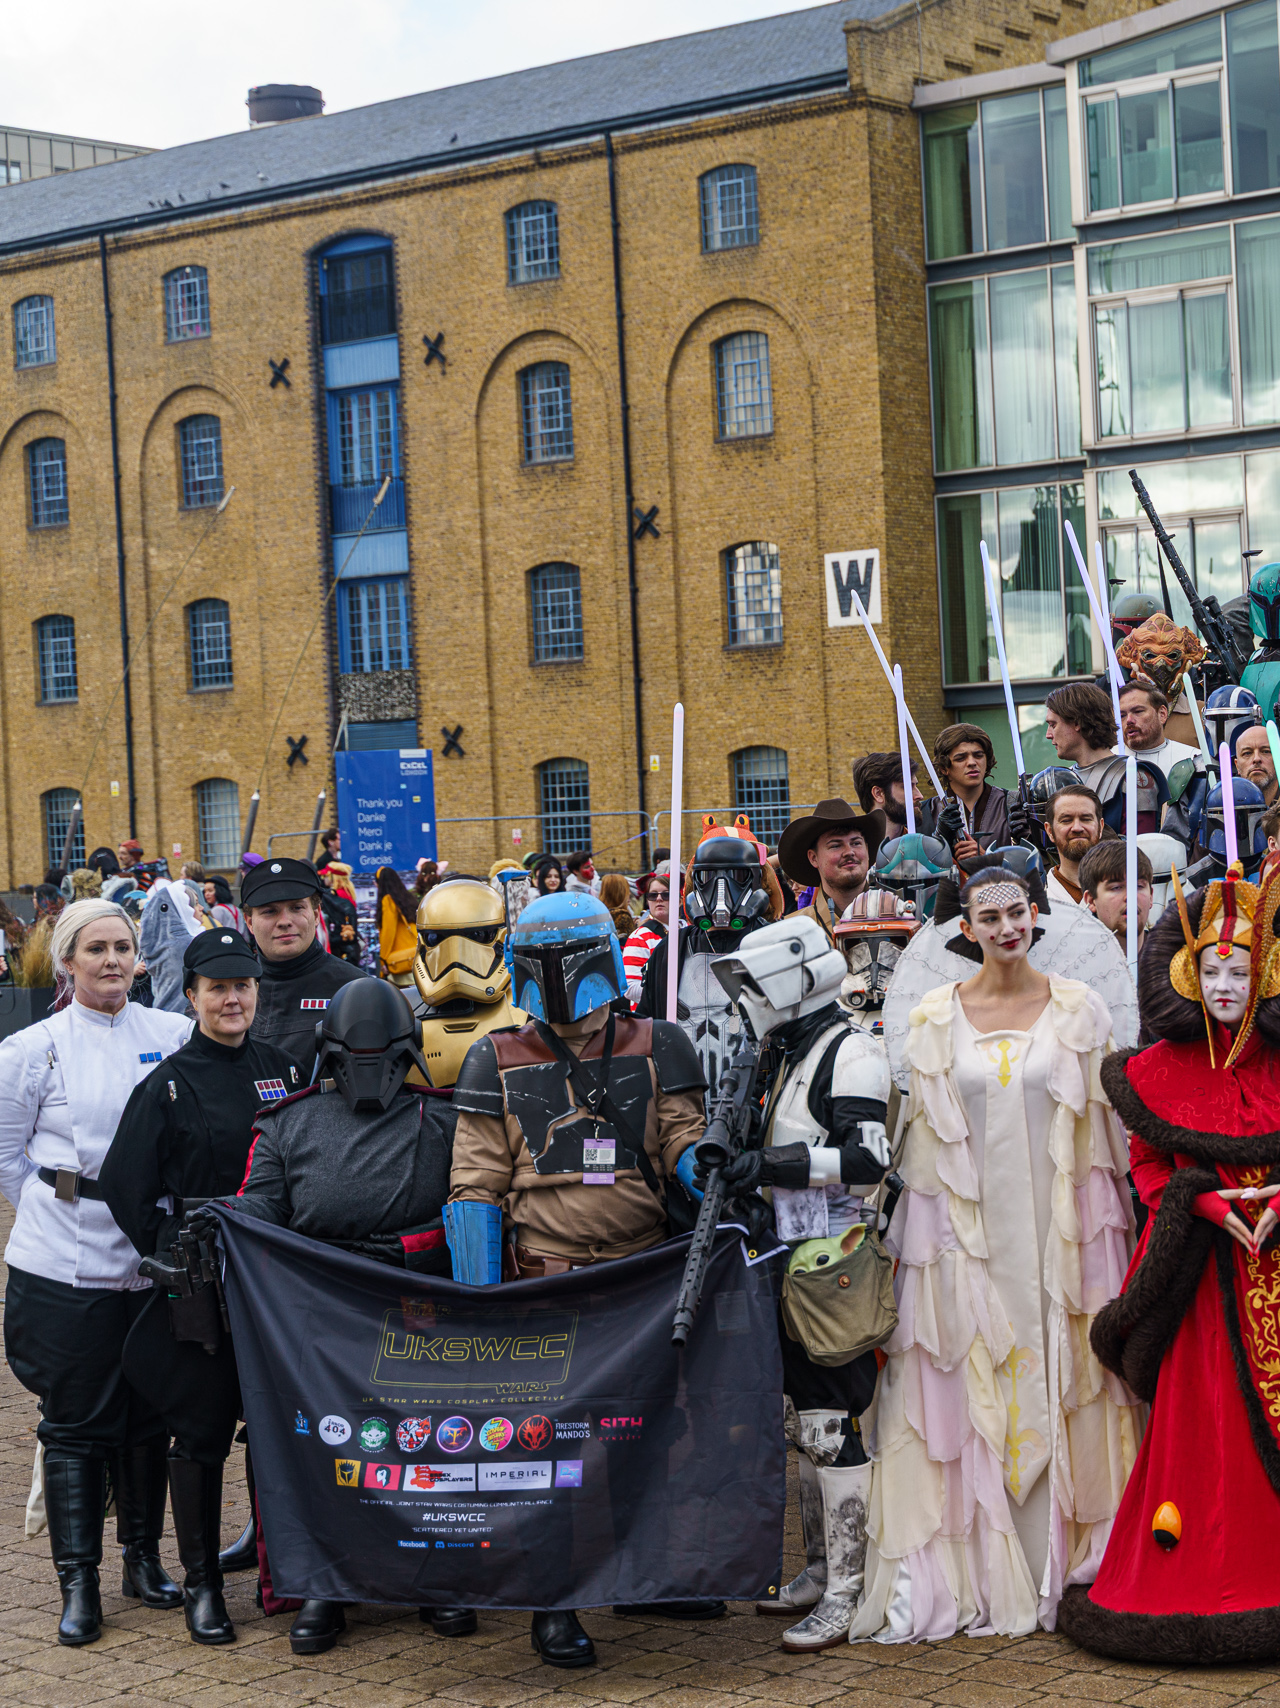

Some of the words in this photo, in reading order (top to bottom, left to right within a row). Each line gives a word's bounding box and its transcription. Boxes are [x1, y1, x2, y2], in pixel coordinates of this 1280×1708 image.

[832, 557, 874, 617] W
[357, 798, 385, 808] Thank
[386, 799, 403, 810] you
[357, 812, 386, 823] Danke
[358, 826, 383, 837] Merci
[359, 841, 383, 851] Dank
[384, 840, 393, 852] je
[359, 855, 393, 866] Gracias
[384, 1332, 568, 1361] UKSWCC
[495, 1382, 550, 1395] WARS
[501, 1395, 565, 1403] COLLECTIVE
[555, 1422, 590, 1430] FIRESTORM
[600, 1416, 643, 1428] SITH
[324, 1424, 346, 1436] 404
[555, 1429, 591, 1439] MANDO'S
[485, 1470, 547, 1478] IMPERIAL
[422, 1513, 486, 1522] #UKSWCC
[400, 1540, 426, 1548] facebook
